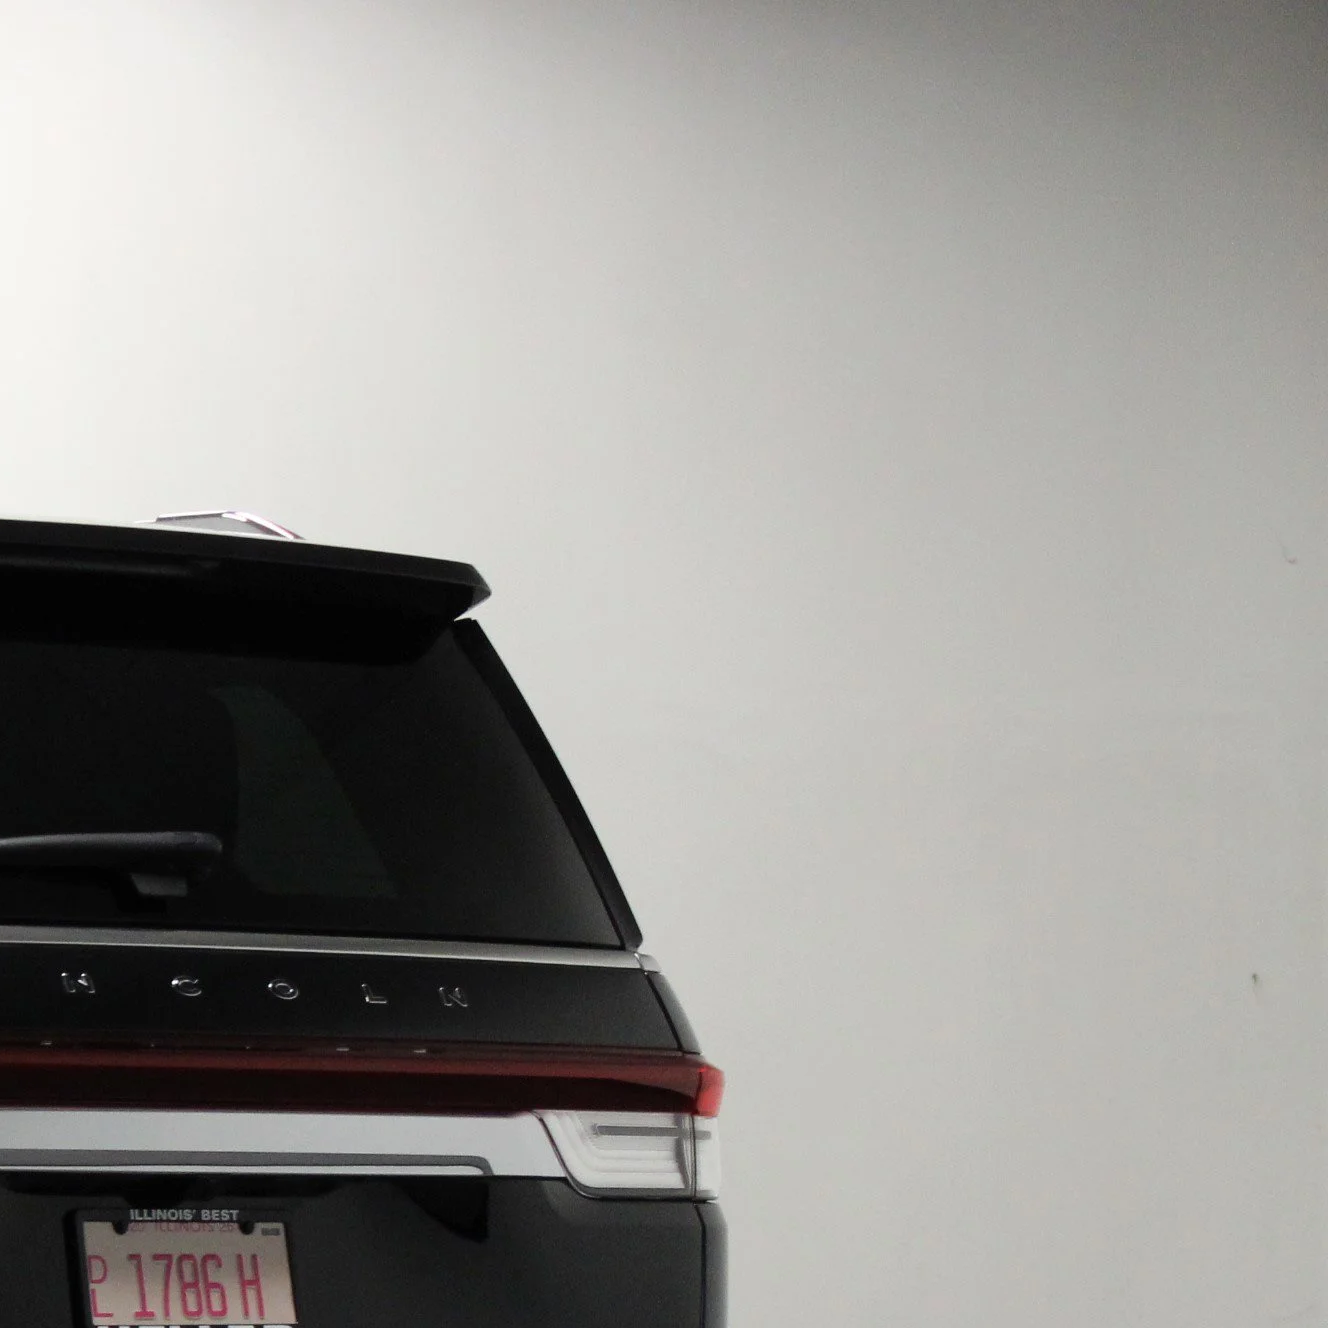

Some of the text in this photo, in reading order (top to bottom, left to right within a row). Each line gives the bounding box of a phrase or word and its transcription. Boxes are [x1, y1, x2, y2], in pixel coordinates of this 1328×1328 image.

[129, 1209, 240, 1221] ILLINOIS' BEST
[127, 1253, 266, 1320] 1786 H
